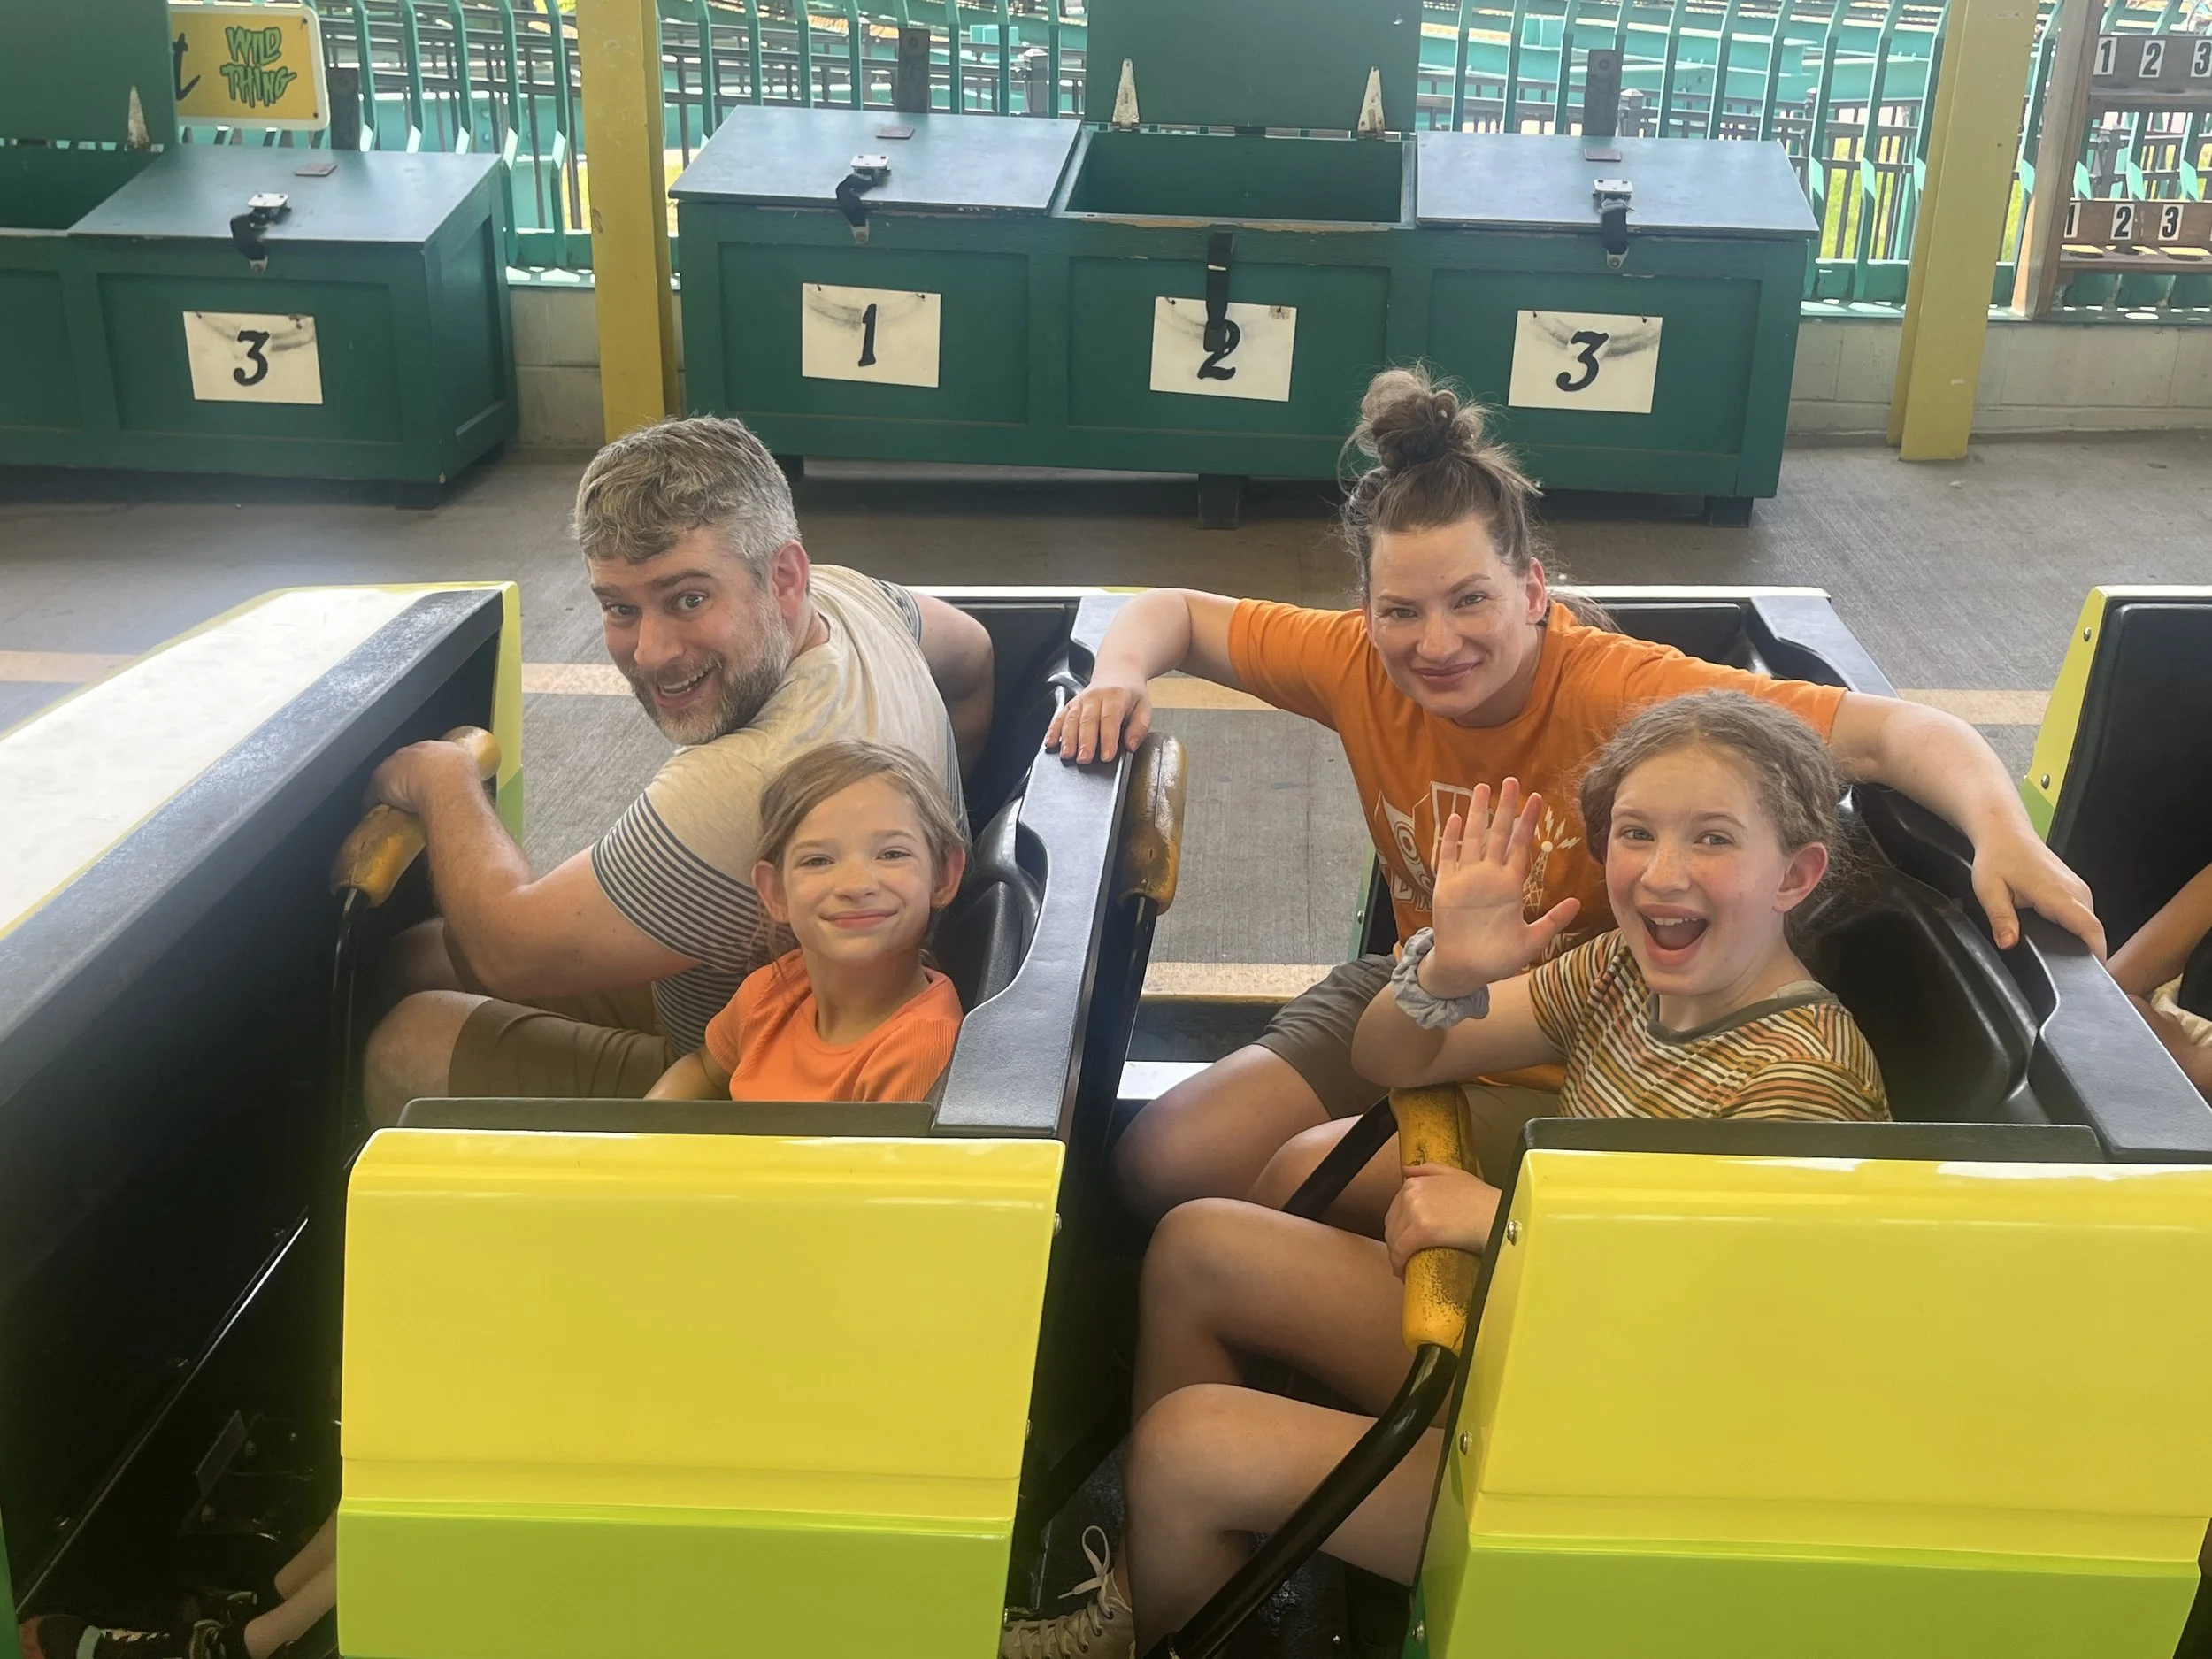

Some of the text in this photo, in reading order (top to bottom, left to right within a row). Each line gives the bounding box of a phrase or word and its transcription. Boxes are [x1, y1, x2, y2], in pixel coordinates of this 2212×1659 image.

[225, 26, 282, 66] WILD
[2101, 40, 2212, 75] 1 2 3
[220, 63, 297, 108] THING
[2066, 204, 2179, 238] 1 2 3
[233, 330, 270, 386] 3
[857, 303, 877, 367] 1
[1197, 319, 1240, 380] 2
[1556, 331, 1609, 392] 3
